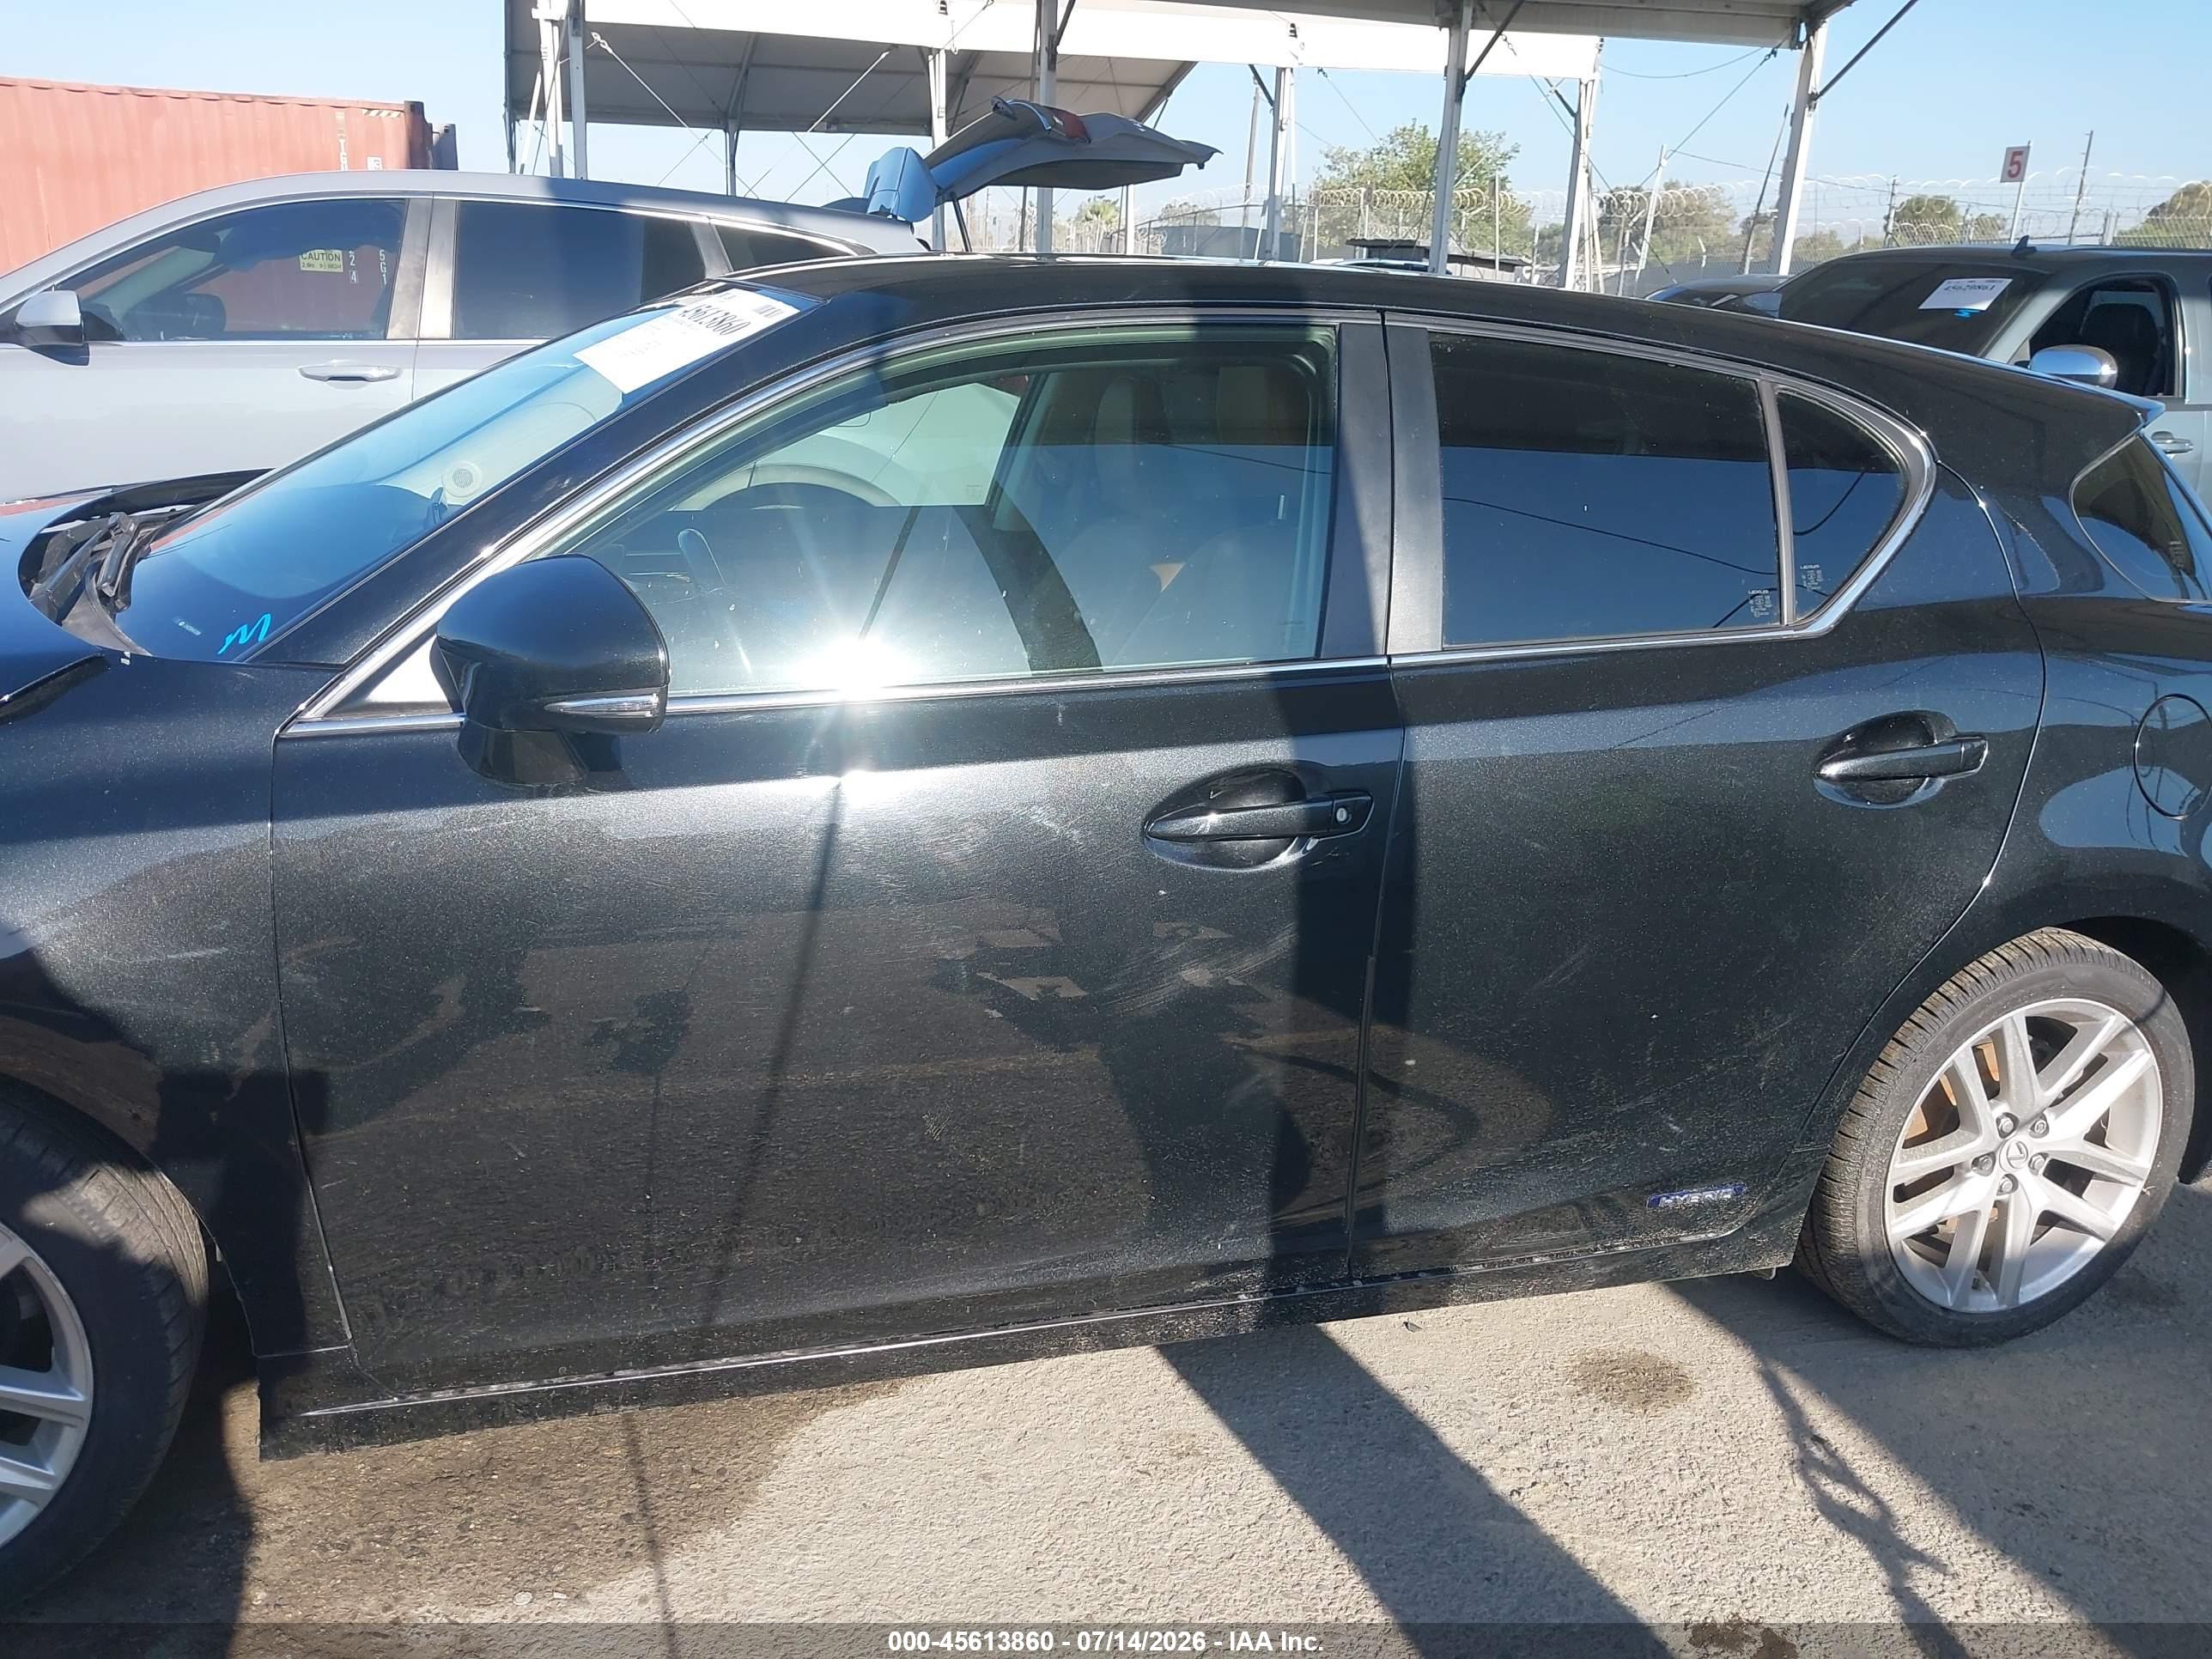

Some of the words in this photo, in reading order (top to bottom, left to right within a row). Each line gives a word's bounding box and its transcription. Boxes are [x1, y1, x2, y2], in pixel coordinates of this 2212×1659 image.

[2008, 151, 2023, 178] 5
[301, 252, 341, 261] CAUTION
[678, 303, 750, 336] 45613860
